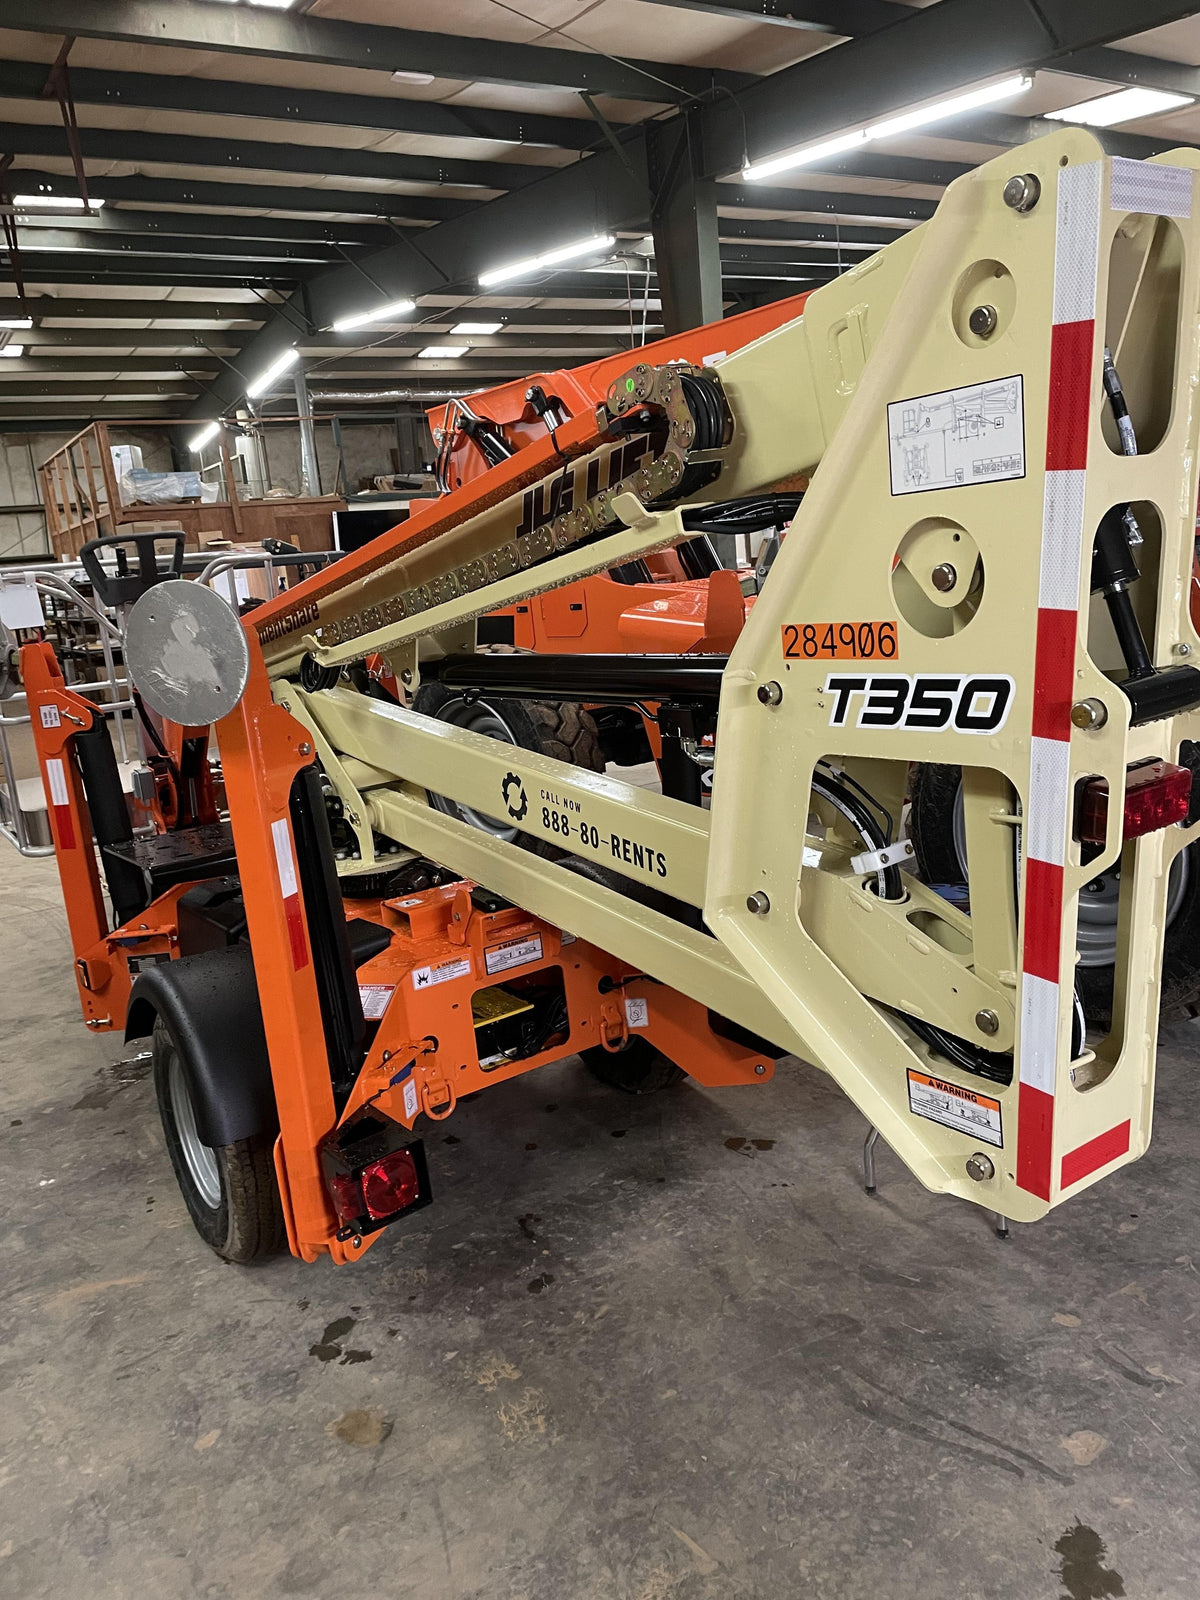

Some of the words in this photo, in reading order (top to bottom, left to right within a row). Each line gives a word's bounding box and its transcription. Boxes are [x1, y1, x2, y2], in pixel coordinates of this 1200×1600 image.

[516, 470, 575, 538] JLG
[784, 622, 897, 658] 284906
[827, 677, 1012, 731] T350
[540, 789, 560, 806] CALL
[563, 797, 582, 814] NOW
[542, 807, 667, 878] 888-80-RENTS
[935, 1081, 978, 1104] WARNING
